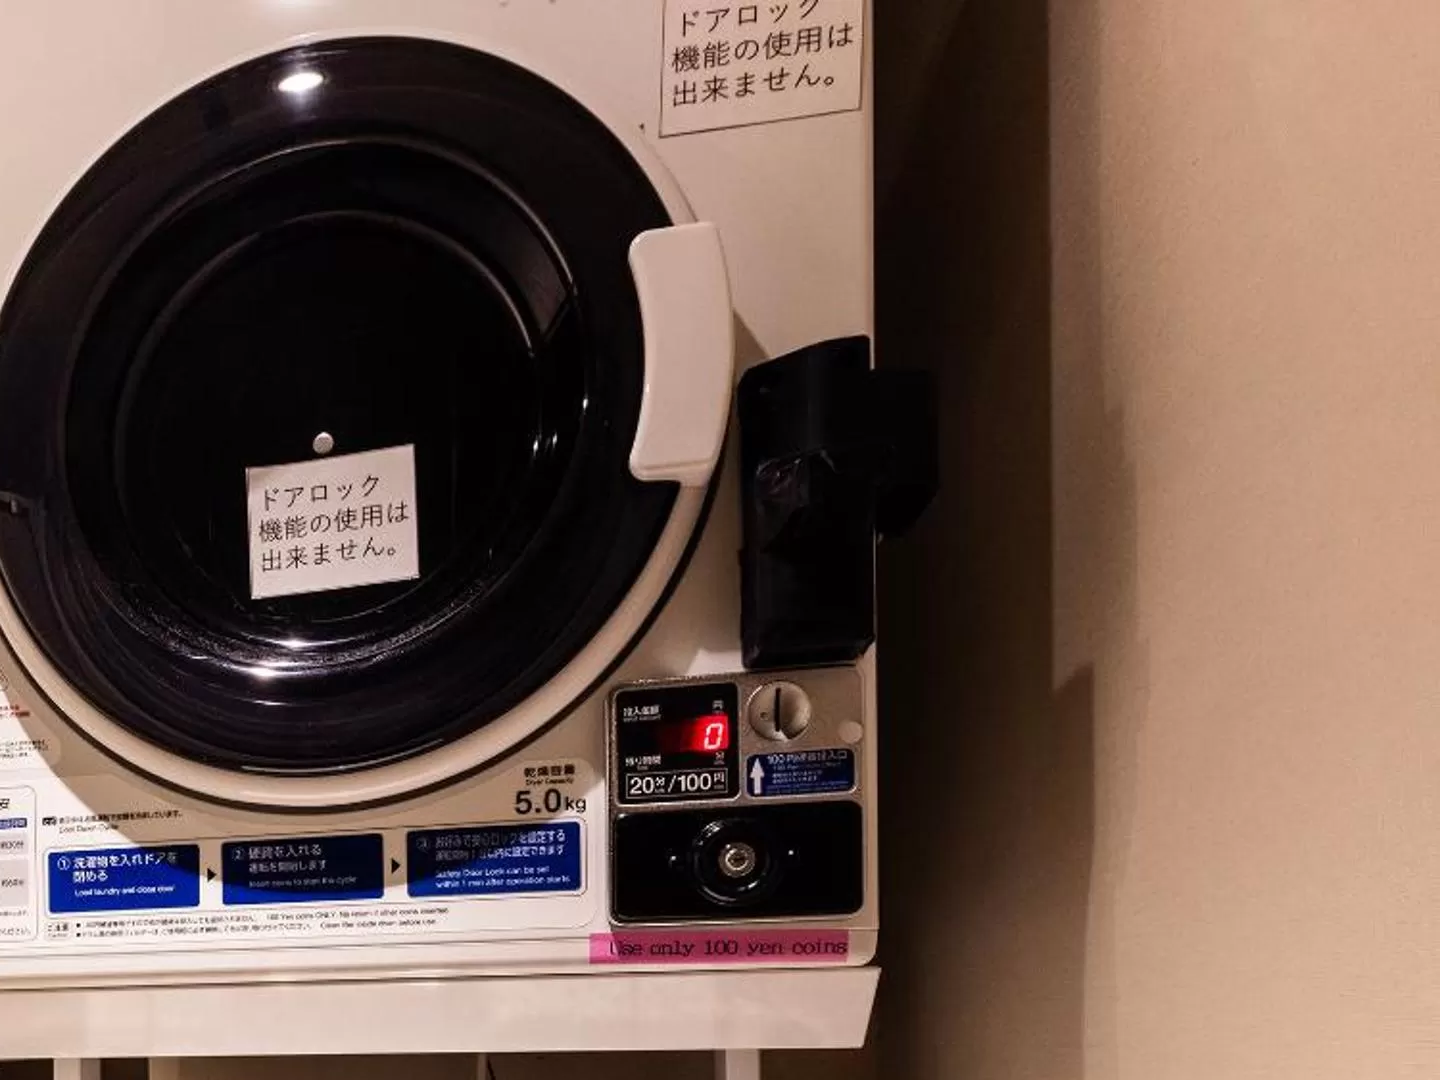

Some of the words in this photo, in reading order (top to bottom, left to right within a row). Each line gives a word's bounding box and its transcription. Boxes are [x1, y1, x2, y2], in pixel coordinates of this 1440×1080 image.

[682, 0, 818, 36] ドアロック
[671, 22, 854, 73] 機能の使用は
[673, 64, 834, 107] 出来ません。
[264, 474, 379, 511] ドアロック
[259, 500, 409, 543] 機能の使用は
[262, 537, 396, 572] 出来ません。
[704, 722, 723, 750] 0
[610, 939, 642, 956] Use
[650, 940, 695, 958] only
[704, 939, 738, 955] 100
[747, 942, 784, 957] yen
[792, 938, 848, 955] coins
